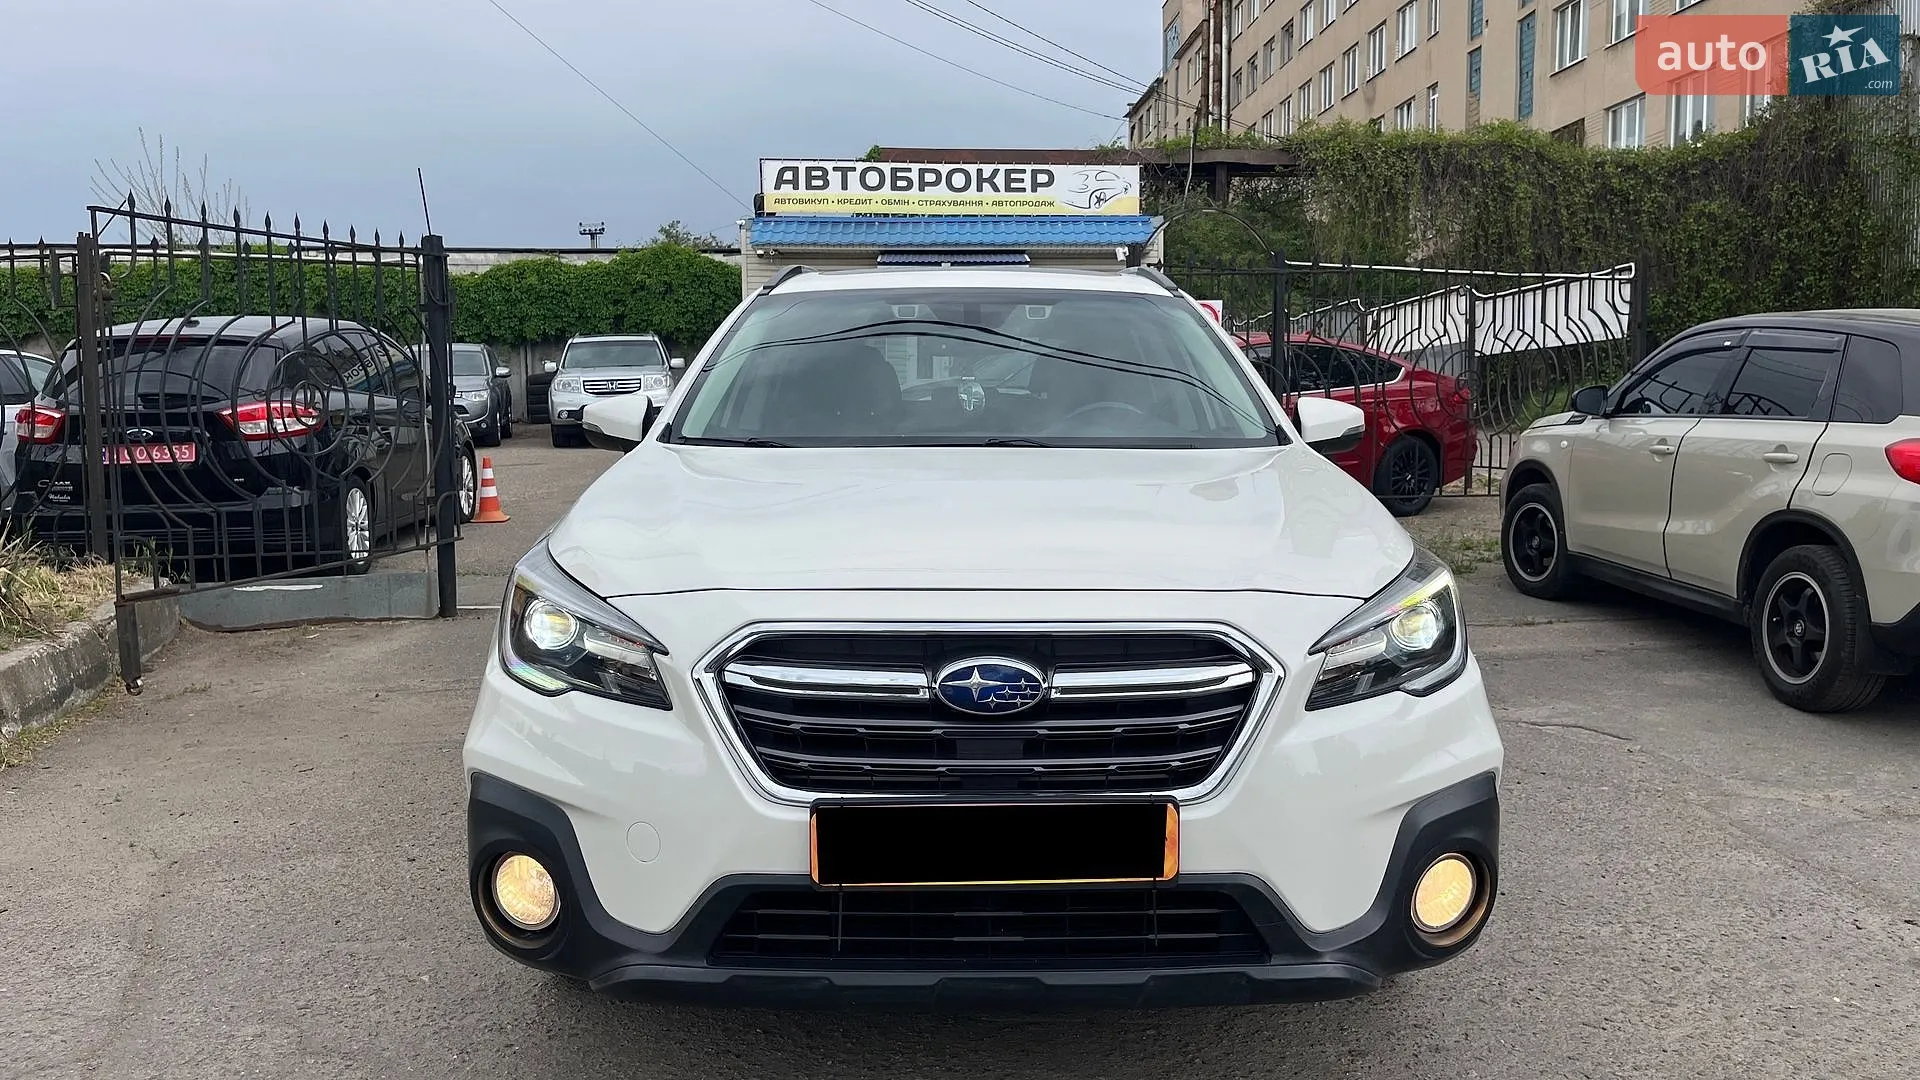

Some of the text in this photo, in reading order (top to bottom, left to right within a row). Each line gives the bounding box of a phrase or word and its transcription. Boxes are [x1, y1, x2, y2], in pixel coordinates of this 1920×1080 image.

[774, 166, 1055, 193] АВТОБРОКЕР
[773, 197, 1055, 208] АВТОВИКУП КРЕДИТ ОБМІН СТРАХУВАННЯ АВТОПРОДАЖ
